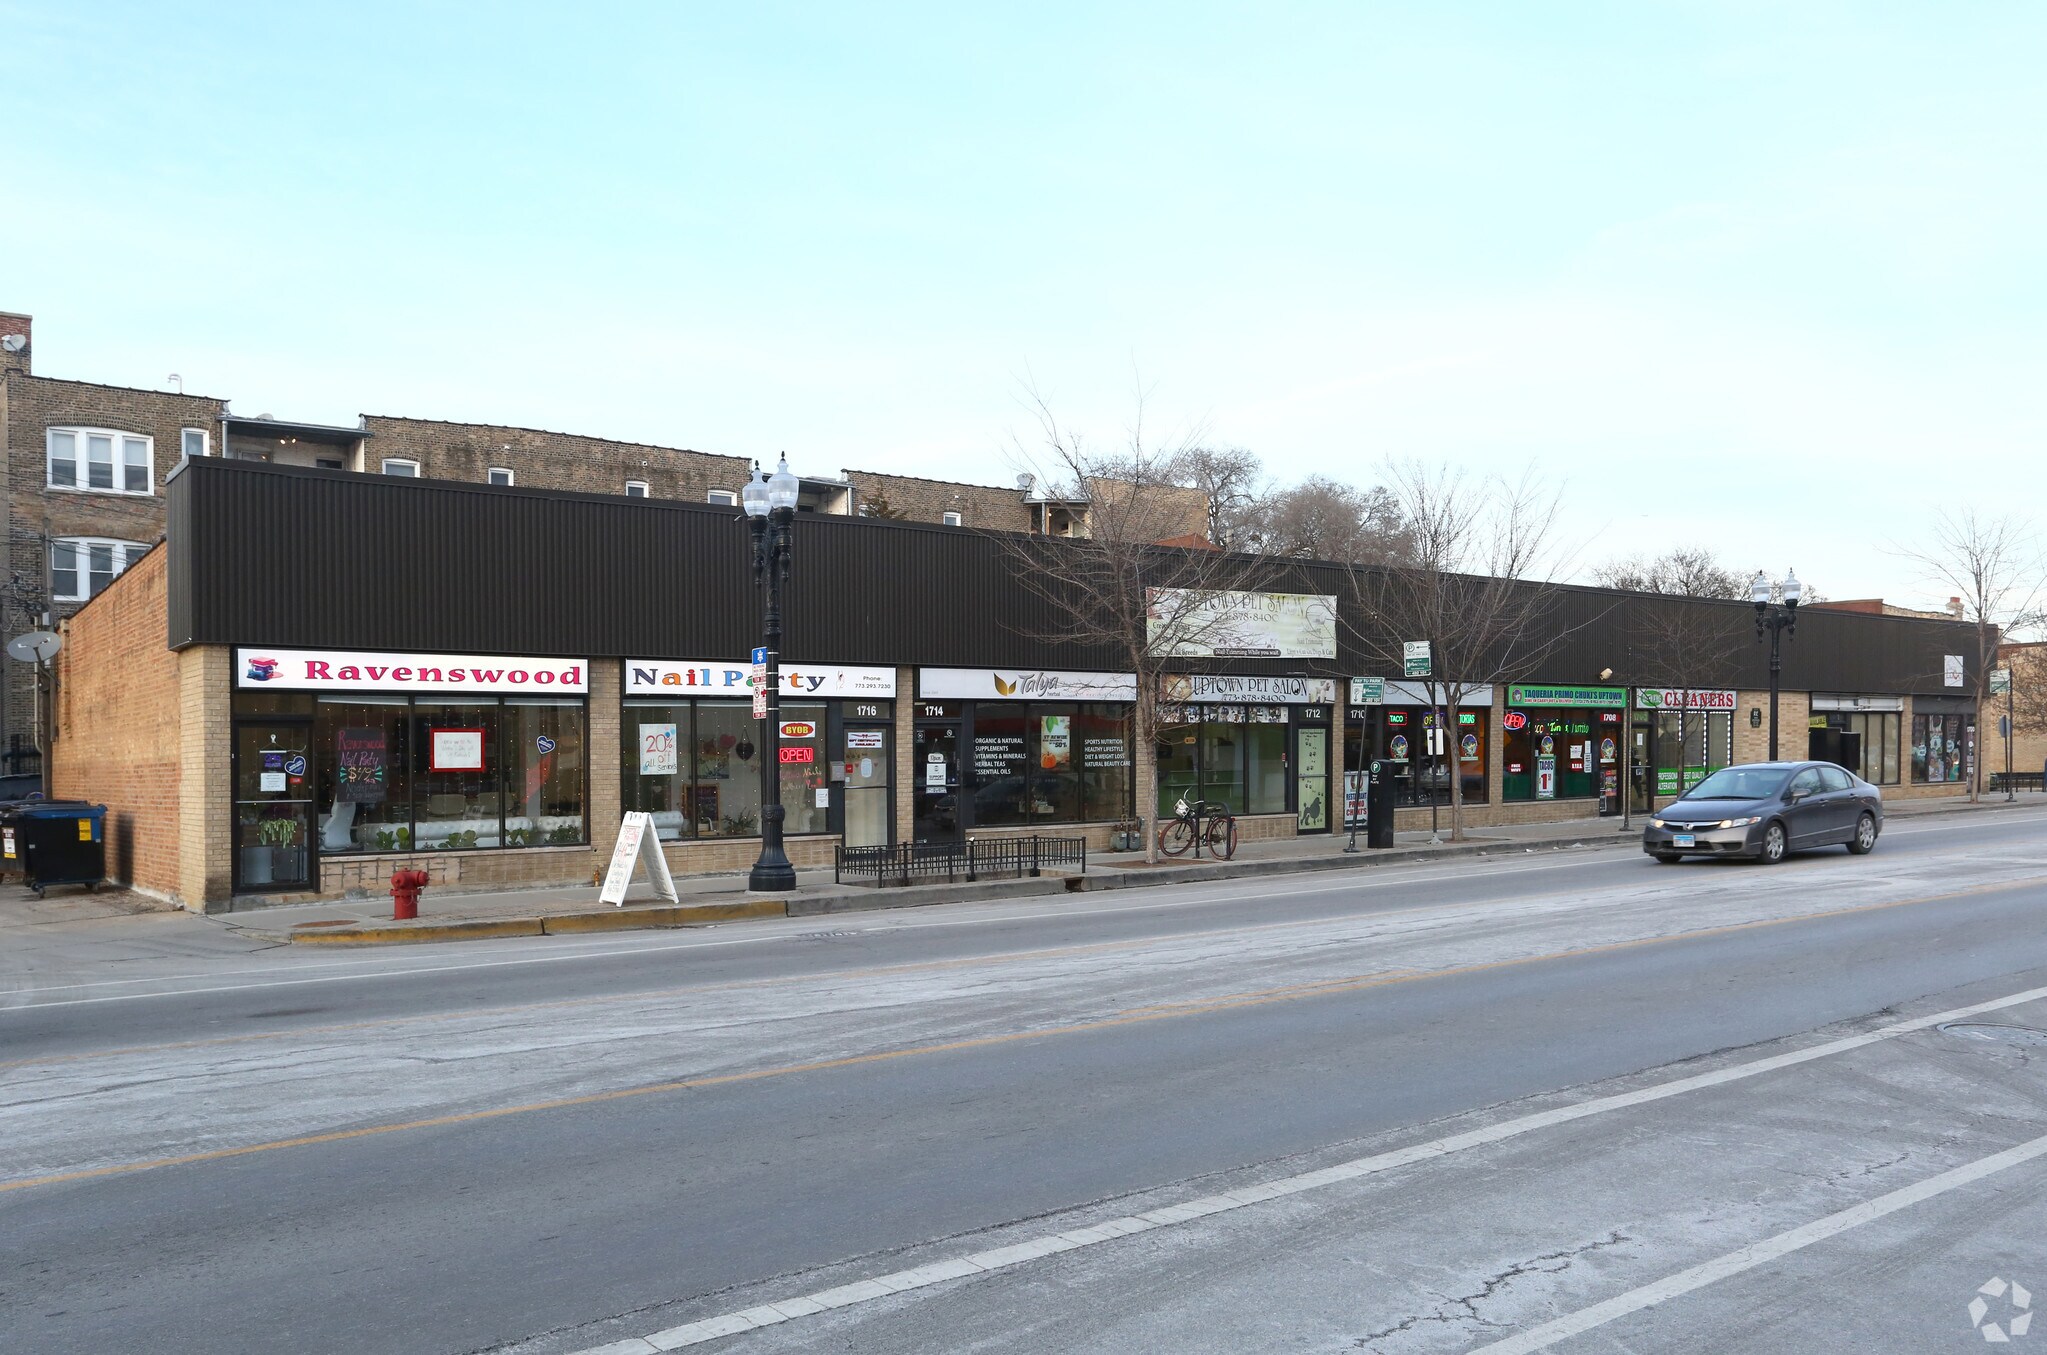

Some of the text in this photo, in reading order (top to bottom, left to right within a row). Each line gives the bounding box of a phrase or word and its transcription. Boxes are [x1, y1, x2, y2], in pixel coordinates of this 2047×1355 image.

[1242, 593, 1265, 610] PET
[304, 660, 583, 686] Ravenswood
[633, 667, 713, 687] Nail
[723, 669, 827, 693] Pty
[1018, 671, 1060, 697] Talya
[1193, 677, 1307, 696] UPTOWN PET SALON
[1524, 690, 1622, 700] TAQUERIA PRIMO CHUKI'S UPTOWN
[857, 705, 877, 716] 1716
[925, 705, 944, 716] 1714
[1305, 708, 1321, 718] 1712
[1603, 713, 1617, 721] 1708
[1504, 713, 1525, 728] OPEN
[785, 726, 809, 734] BYOB
[645, 733, 673, 753] 20%
[340, 751, 358, 767] Nail
[781, 749, 811, 761] OPEN
[1540, 761, 1554, 771] TACOS
